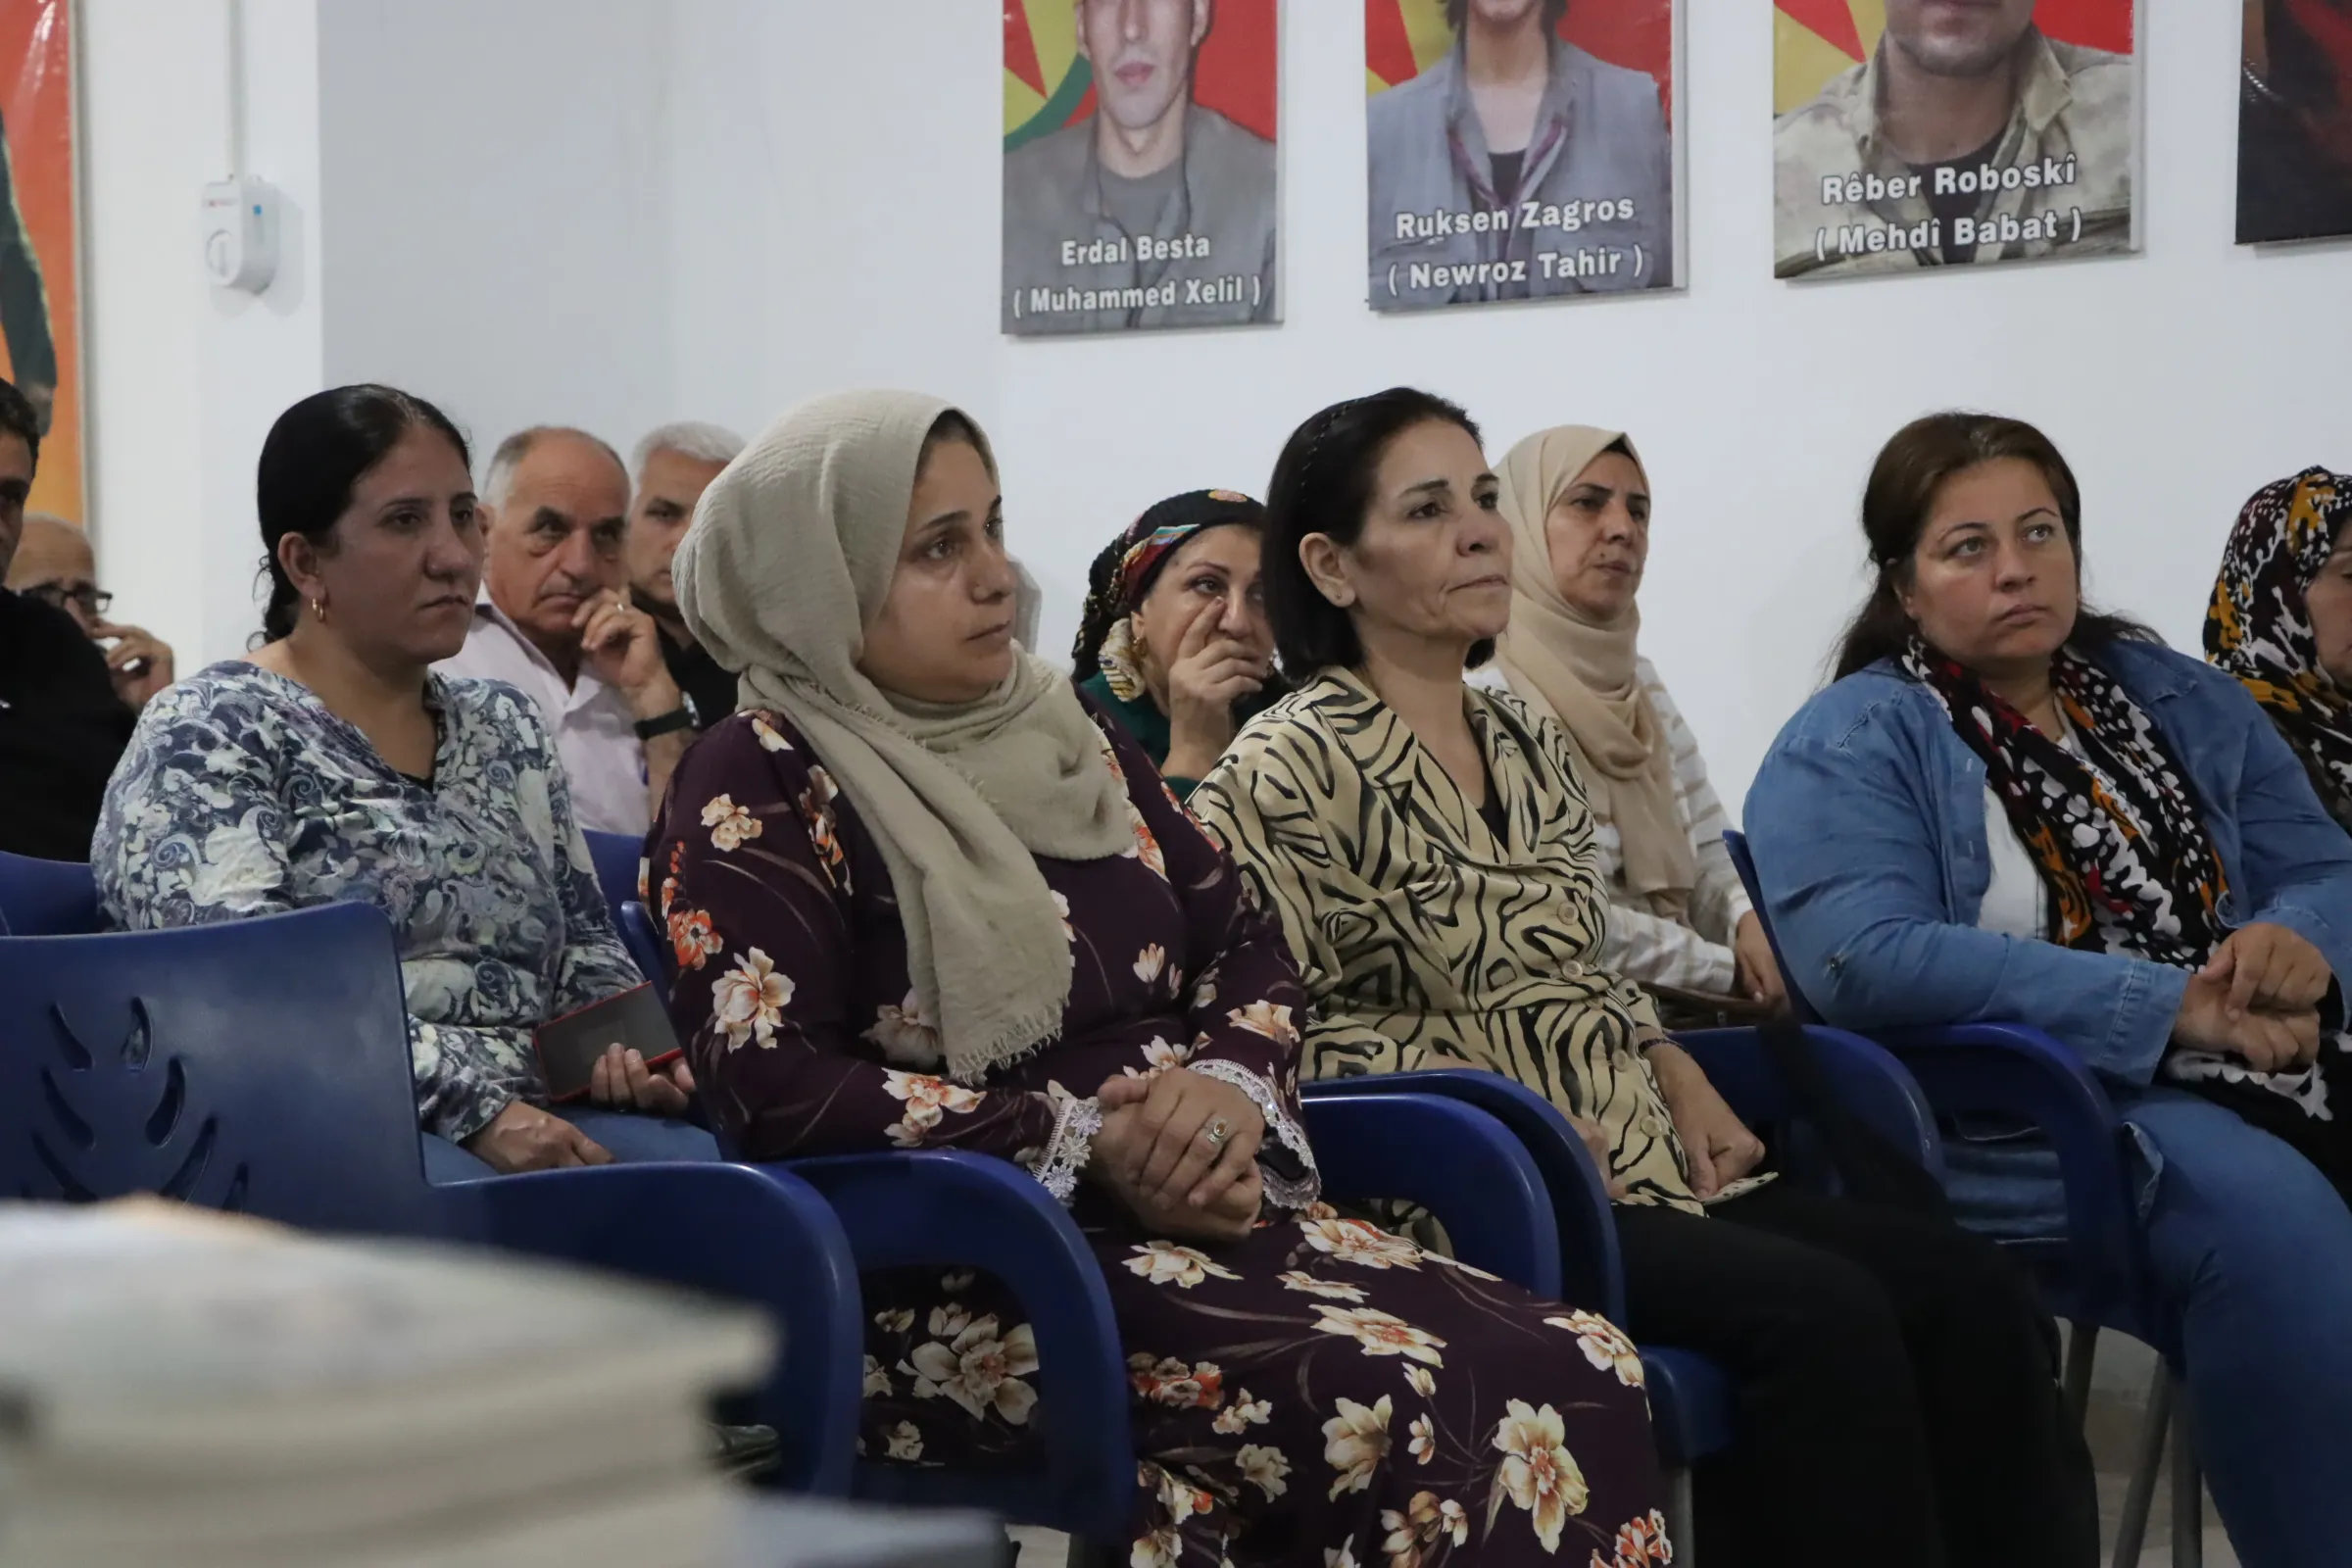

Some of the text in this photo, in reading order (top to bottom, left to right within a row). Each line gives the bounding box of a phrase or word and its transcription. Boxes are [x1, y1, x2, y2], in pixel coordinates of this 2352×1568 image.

[1822, 154, 2078, 204] Rêber Roboskî
[1396, 198, 1635, 238] Ruksen Zagros
[1838, 219, 1940, 254] Mehdî
[1954, 211, 2058, 245] Babat
[1061, 233, 1210, 266] Erdal Besta
[1410, 260, 1526, 289] Newroz
[1538, 247, 1622, 278] Tahir
[1030, 280, 1176, 313] Muhammed
[1185, 275, 1243, 304] Xelîl
